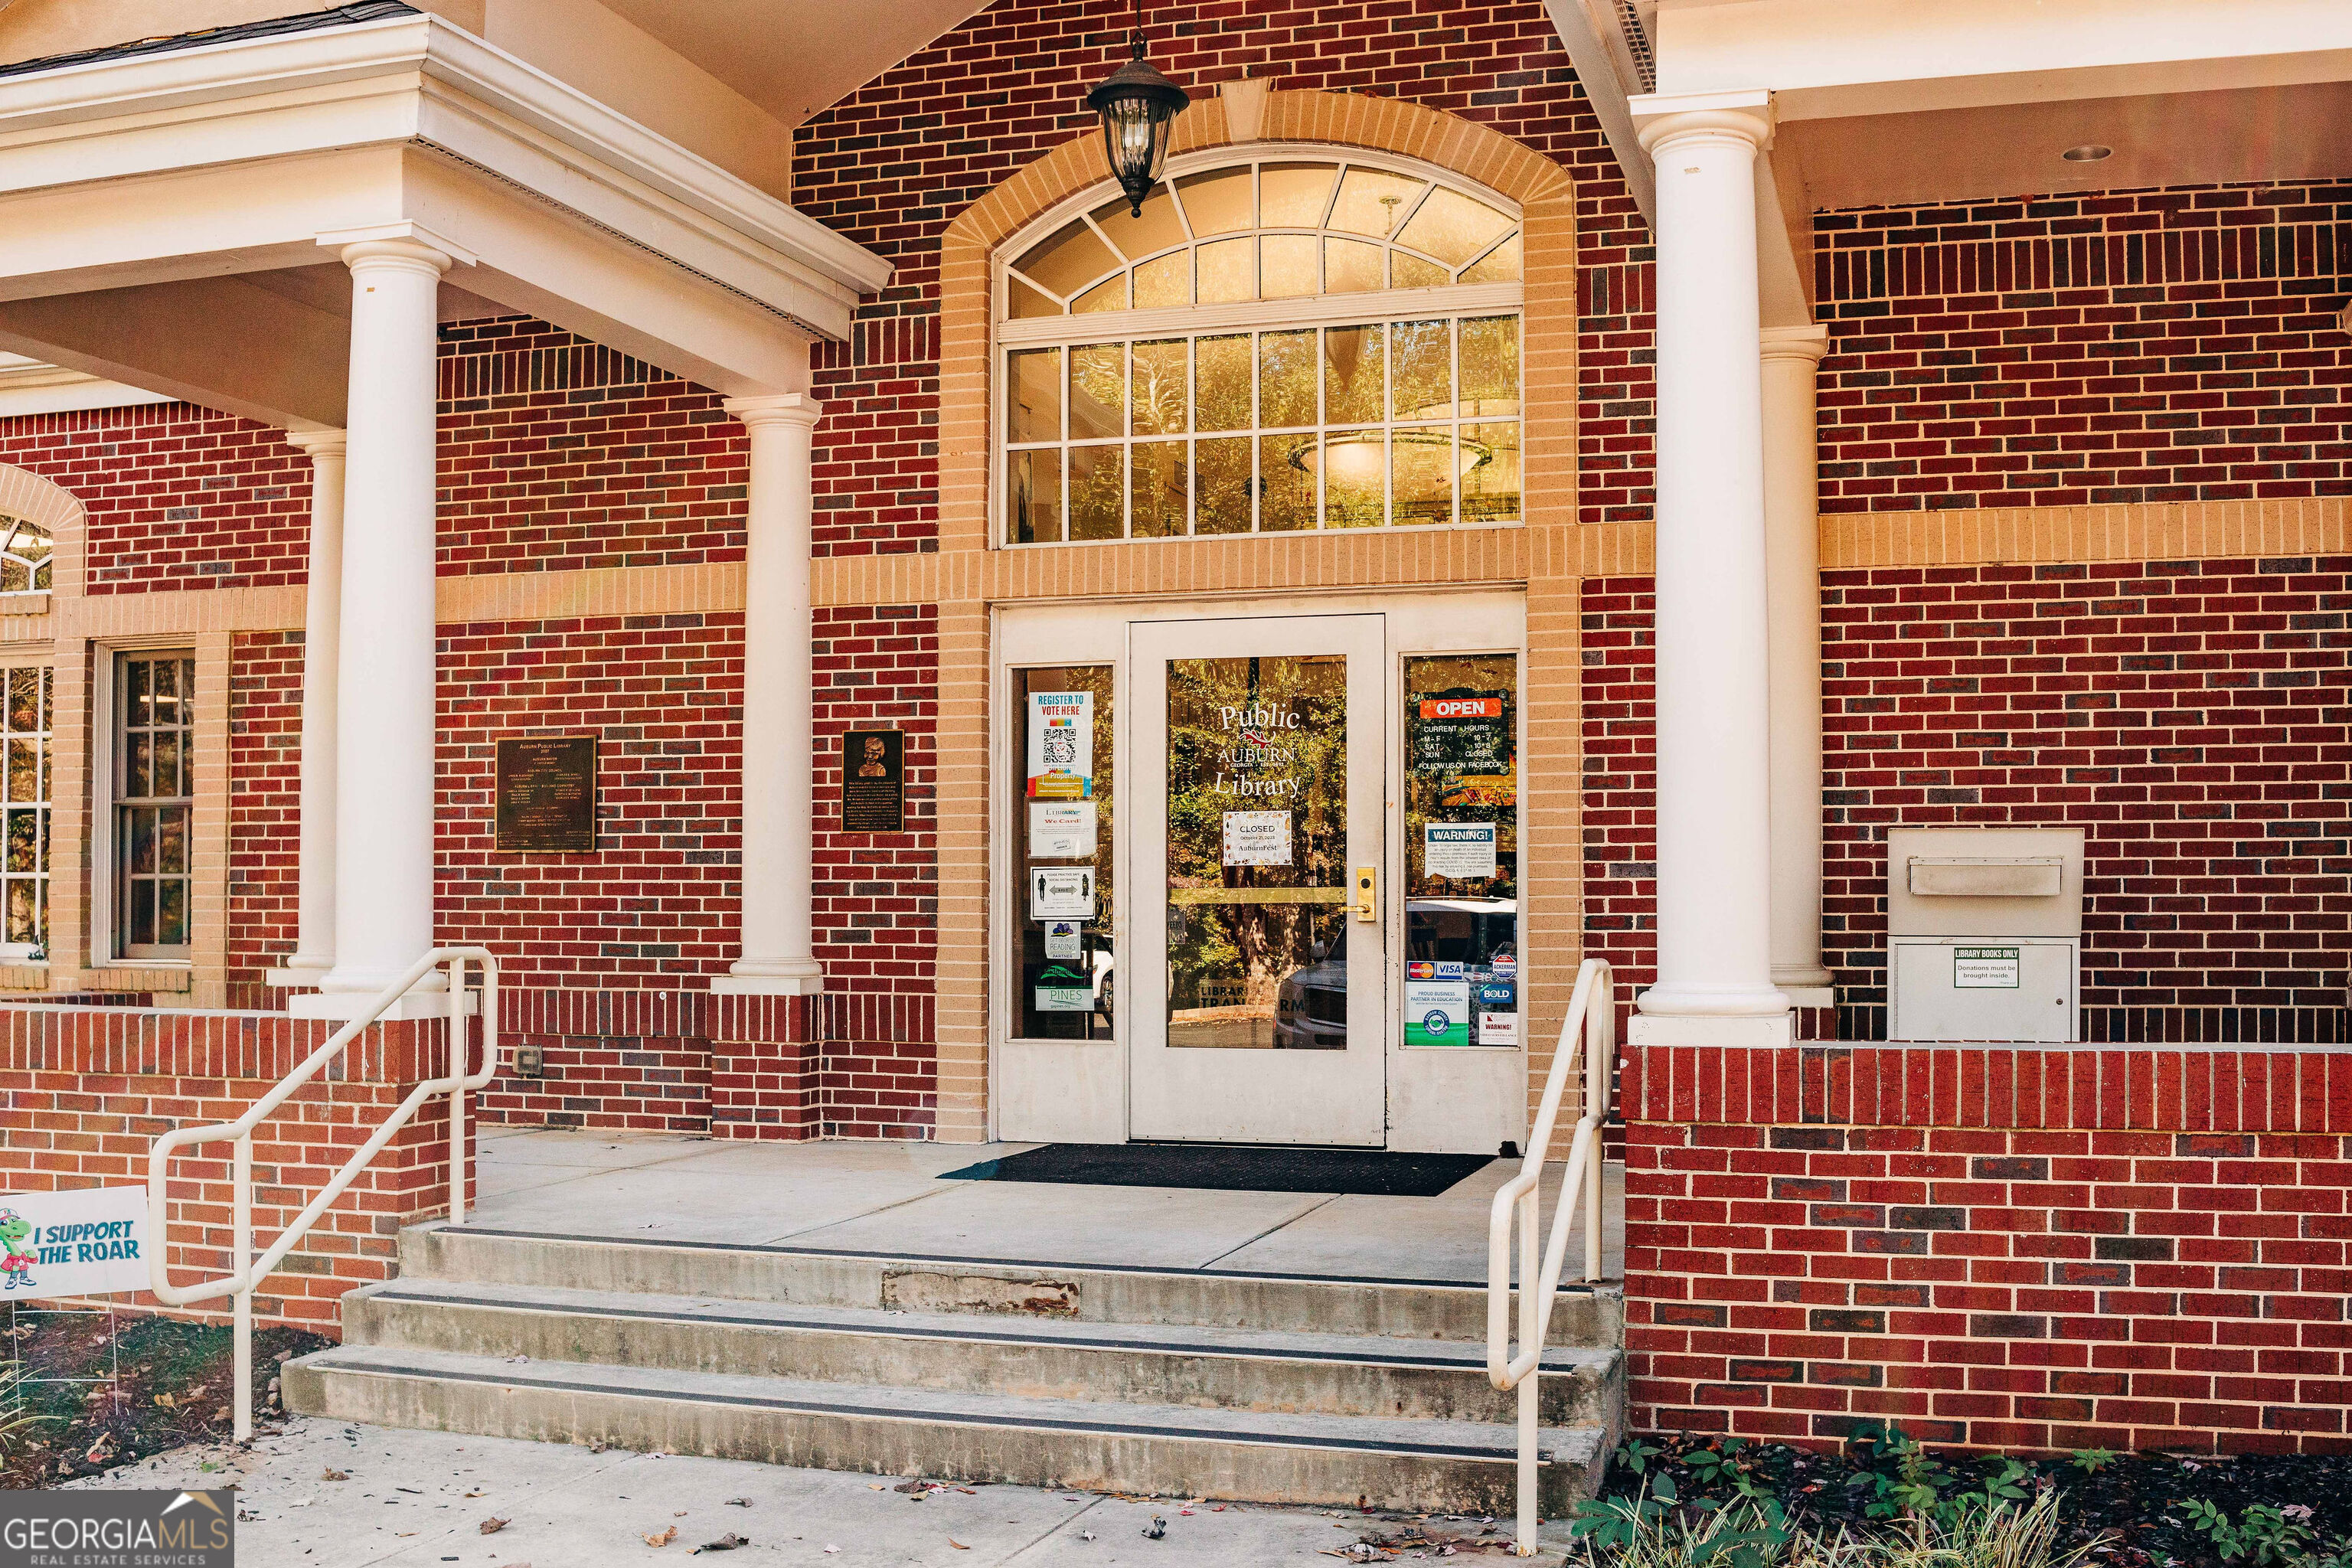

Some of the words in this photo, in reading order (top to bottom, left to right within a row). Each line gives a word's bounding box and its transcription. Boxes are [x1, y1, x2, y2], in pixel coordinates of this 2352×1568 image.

[1038, 695, 1073, 704] REGISTER
[1075, 695, 1083, 704] TO
[1042, 706, 1060, 715] VOTE
[1061, 706, 1080, 715] HERE
[1436, 701, 1485, 715] OPEN
[1219, 702, 1300, 730] Public
[1217, 747, 1298, 763] AUBURN
[1214, 772, 1302, 799] Library
[1433, 831, 1488, 840] WARNING!
[1955, 949, 1981, 958] LIBRARY
[1981, 949, 2001, 958] BOOKS
[2003, 949, 2018, 958] ONLY
[1439, 965, 1461, 973] VISA
[1050, 990, 1083, 1000] PINES
[34, 1227, 41, 1244] I
[46, 1220, 133, 1243] SUPPORT
[38, 1246, 73, 1264] THE
[77, 1240, 140, 1263] ROAR
